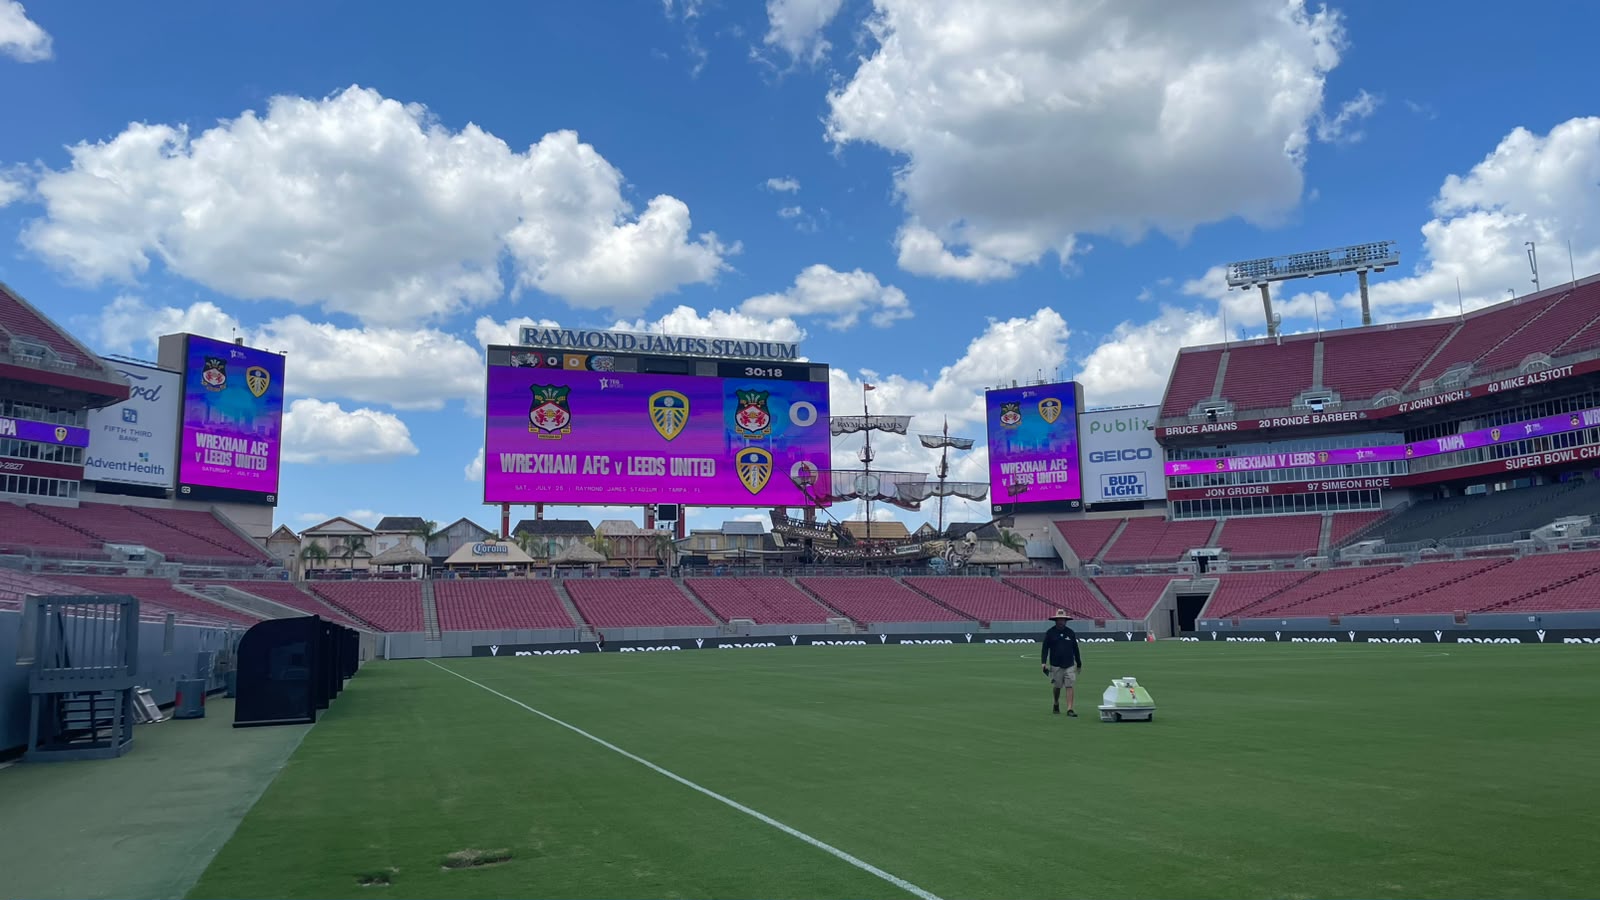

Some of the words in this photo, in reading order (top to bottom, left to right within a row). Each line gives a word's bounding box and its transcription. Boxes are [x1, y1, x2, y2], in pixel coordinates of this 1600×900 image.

[524, 327, 637, 350] RAYMOND
[639, 335, 708, 354] JAMES
[712, 339, 798, 359] STADIUM
[745, 367, 783, 378] 30:18
[1487, 383, 1499, 392] 40
[1500, 376, 1525, 390] MIKE
[1527, 365, 1573, 384] ALSTOTT
[1398, 403, 1408, 413] 47
[1410, 397, 1433, 411] JOHN
[1434, 390, 1464, 405] LYNCH
[1090, 417, 1149, 434] Publix
[1259, 420, 1271, 428] 20
[1273, 415, 1310, 427] RONDÉ
[1312, 411, 1358, 424] BARBER
[104, 425, 127, 434] FIFTH
[129, 428, 153, 438] THIRD
[1165, 425, 1198, 436] BRUCE
[1201, 422, 1238, 433] ARIANS
[118, 435, 139, 443] BANK
[195, 432, 248, 454] WREXHAM
[250, 440, 269, 457] AFC
[1437, 435, 1465, 452] TAMPA
[204, 449, 233, 467] LEEDS
[235, 453, 268, 471] UNITED
[1089, 447, 1152, 463] GEICO
[1228, 455, 1276, 470] WREXHAM
[1289, 452, 1316, 466] LEEDS
[1505, 455, 1541, 470] SUPER
[1544, 450, 1578, 464] BOWL
[85, 456, 165, 475] AdventHealth
[500, 453, 577, 474] WREXHAM
[582, 455, 610, 475] AFC
[627, 456, 666, 476] LEEDS
[670, 457, 716, 477] UNITED
[1000, 460, 1047, 474] WREXHAM
[1050, 459, 1068, 471] AFC
[1037, 470, 1068, 484] UNITED
[1108, 475, 1138, 486] BUD
[1307, 483, 1319, 491] 97
[1322, 480, 1362, 490] SIMEON
[1365, 478, 1390, 487] RICE
[1104, 485, 1144, 496] LIGHT
[1205, 488, 1225, 497] JON
[1227, 486, 1269, 495] GRUDEN
[472, 543, 508, 556] Corona
